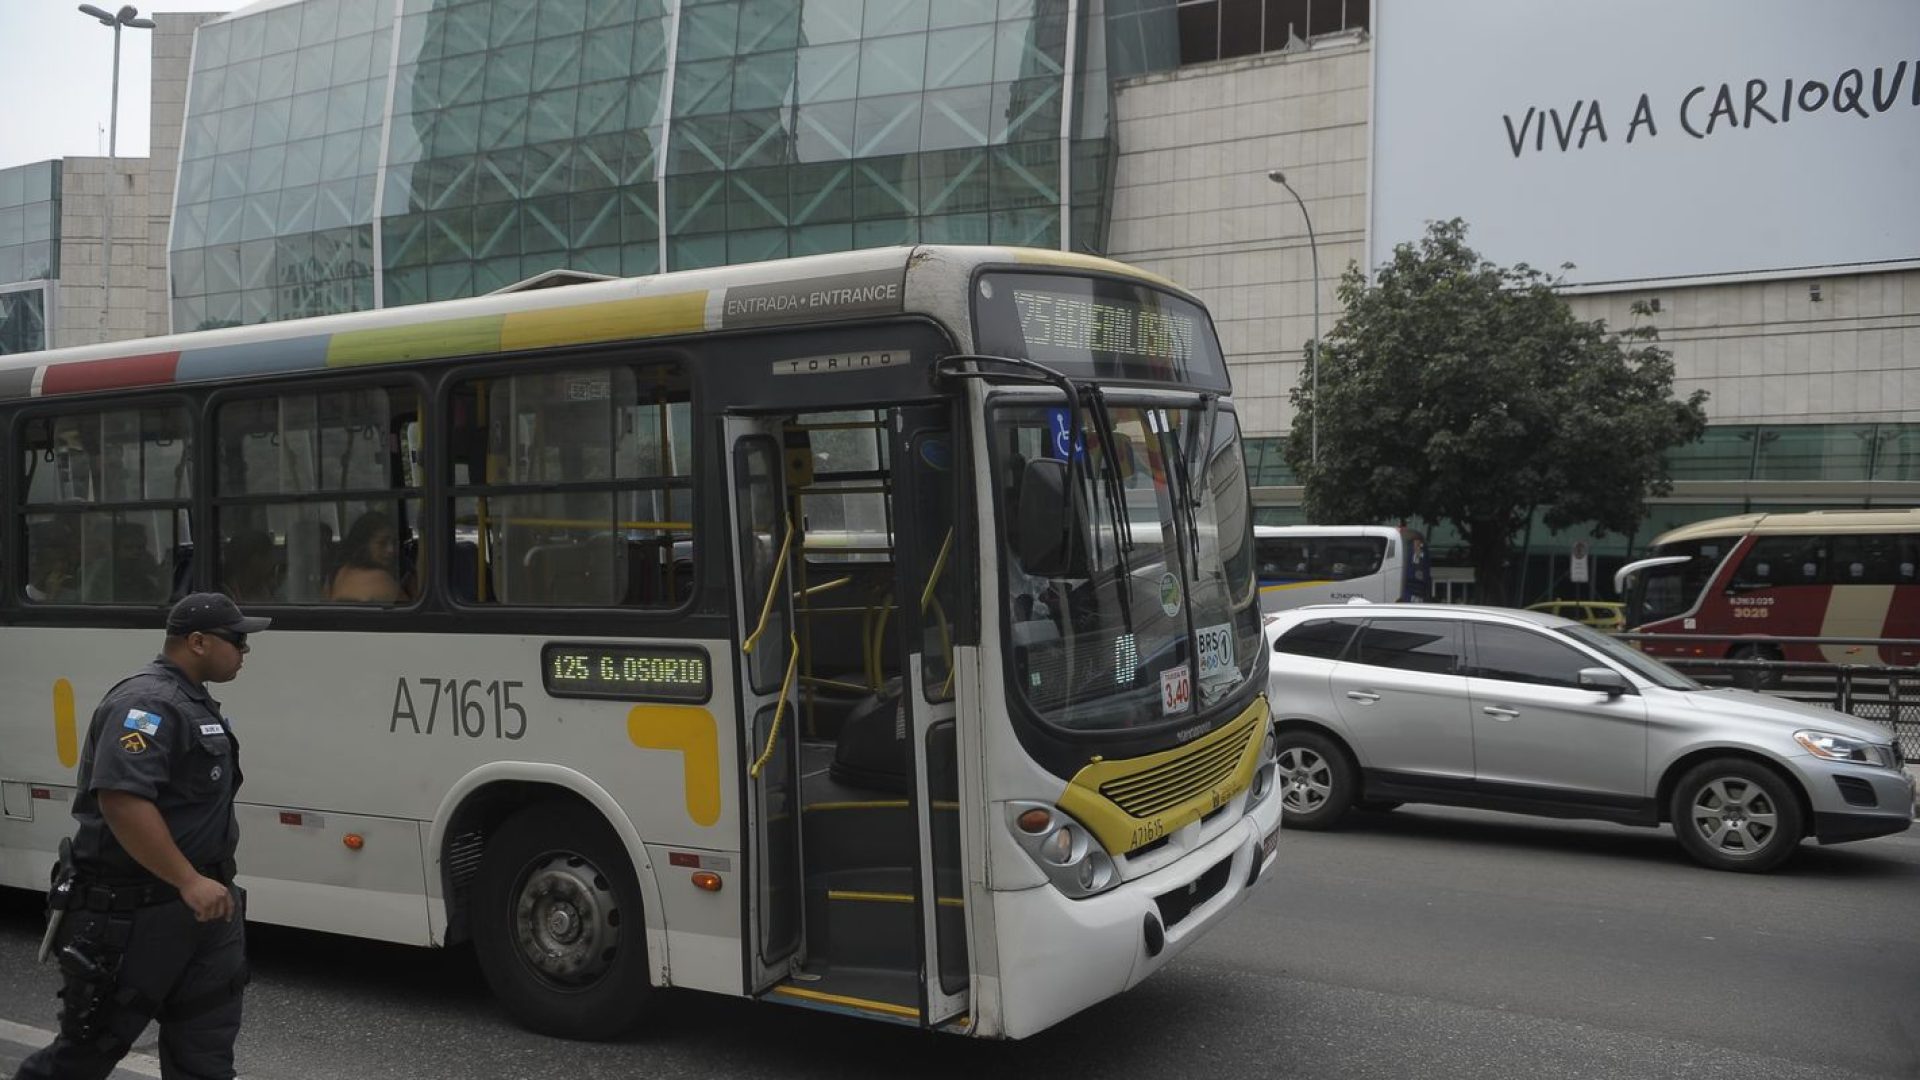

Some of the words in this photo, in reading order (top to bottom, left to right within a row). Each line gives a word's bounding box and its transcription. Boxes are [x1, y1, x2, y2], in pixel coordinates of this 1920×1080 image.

[1503, 100, 1607, 158] VIVA
[1626, 93, 1658, 143] A
[727, 294, 798, 315] ENTRADA
[809, 284, 897, 307] ENTRANCE
[790, 353, 891, 373] TORINO
[1199, 632, 1218, 654] BRS
[554, 655, 590, 680] 125
[600, 656, 703, 684] G.OSORIO
[389, 677, 528, 741] A71615
[1165, 679, 1189, 709] 3,40
[1130, 818, 1164, 849] A71615
